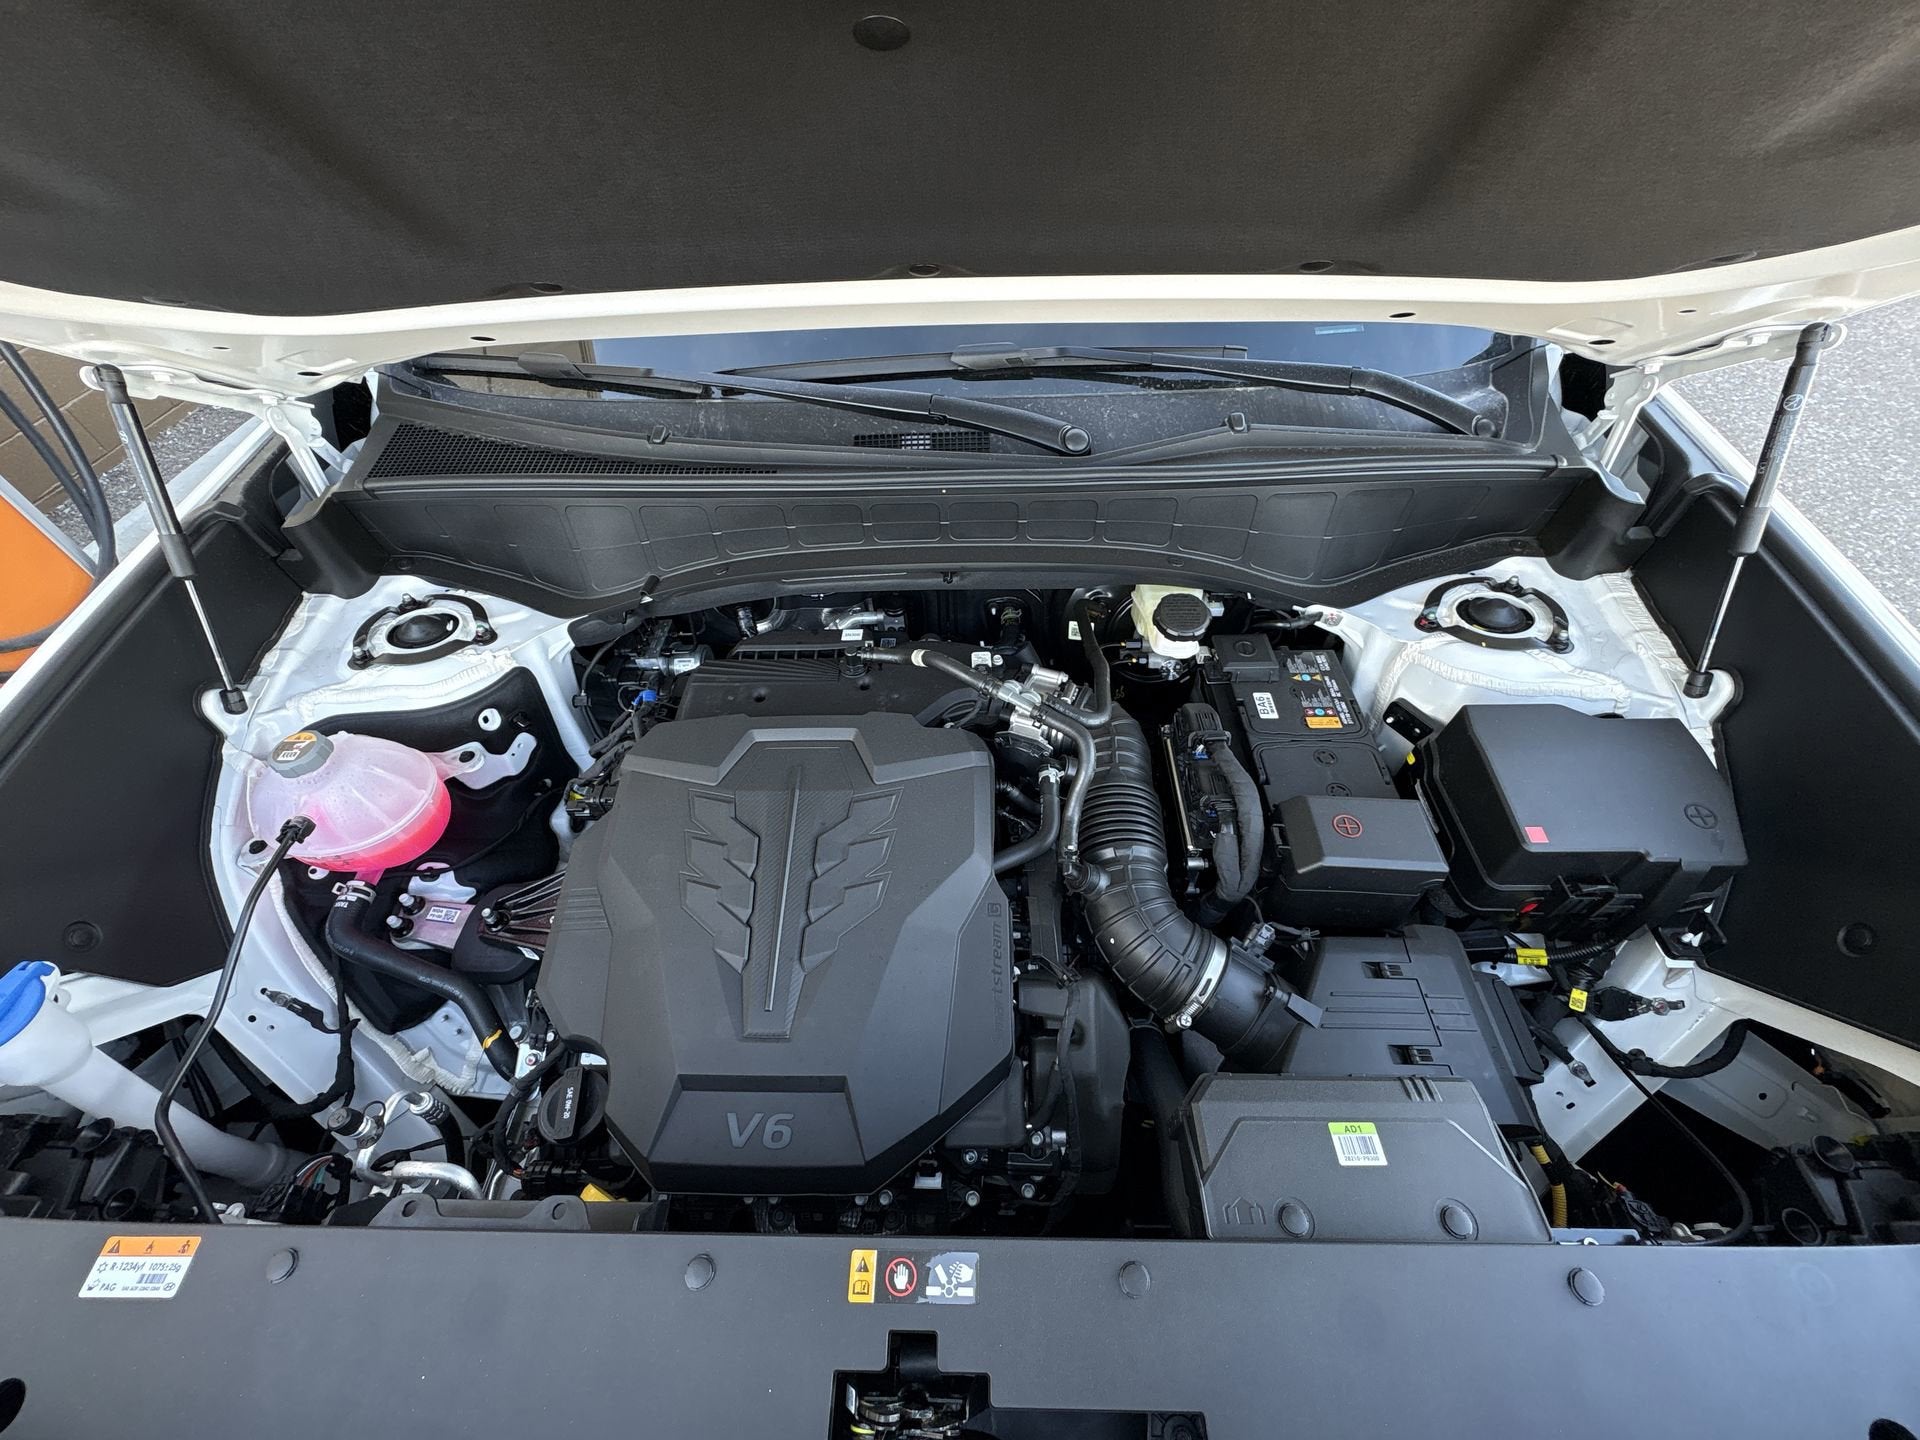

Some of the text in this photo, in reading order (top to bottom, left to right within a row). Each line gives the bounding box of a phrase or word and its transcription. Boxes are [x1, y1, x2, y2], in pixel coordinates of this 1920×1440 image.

[1255, 696, 1270, 715] BA6
[563, 1086, 574, 1119] SAE 0W-20
[726, 1112, 795, 1150] V6
[1344, 1124, 1363, 1134] AD1
[98, 1282, 117, 1292] PAG
